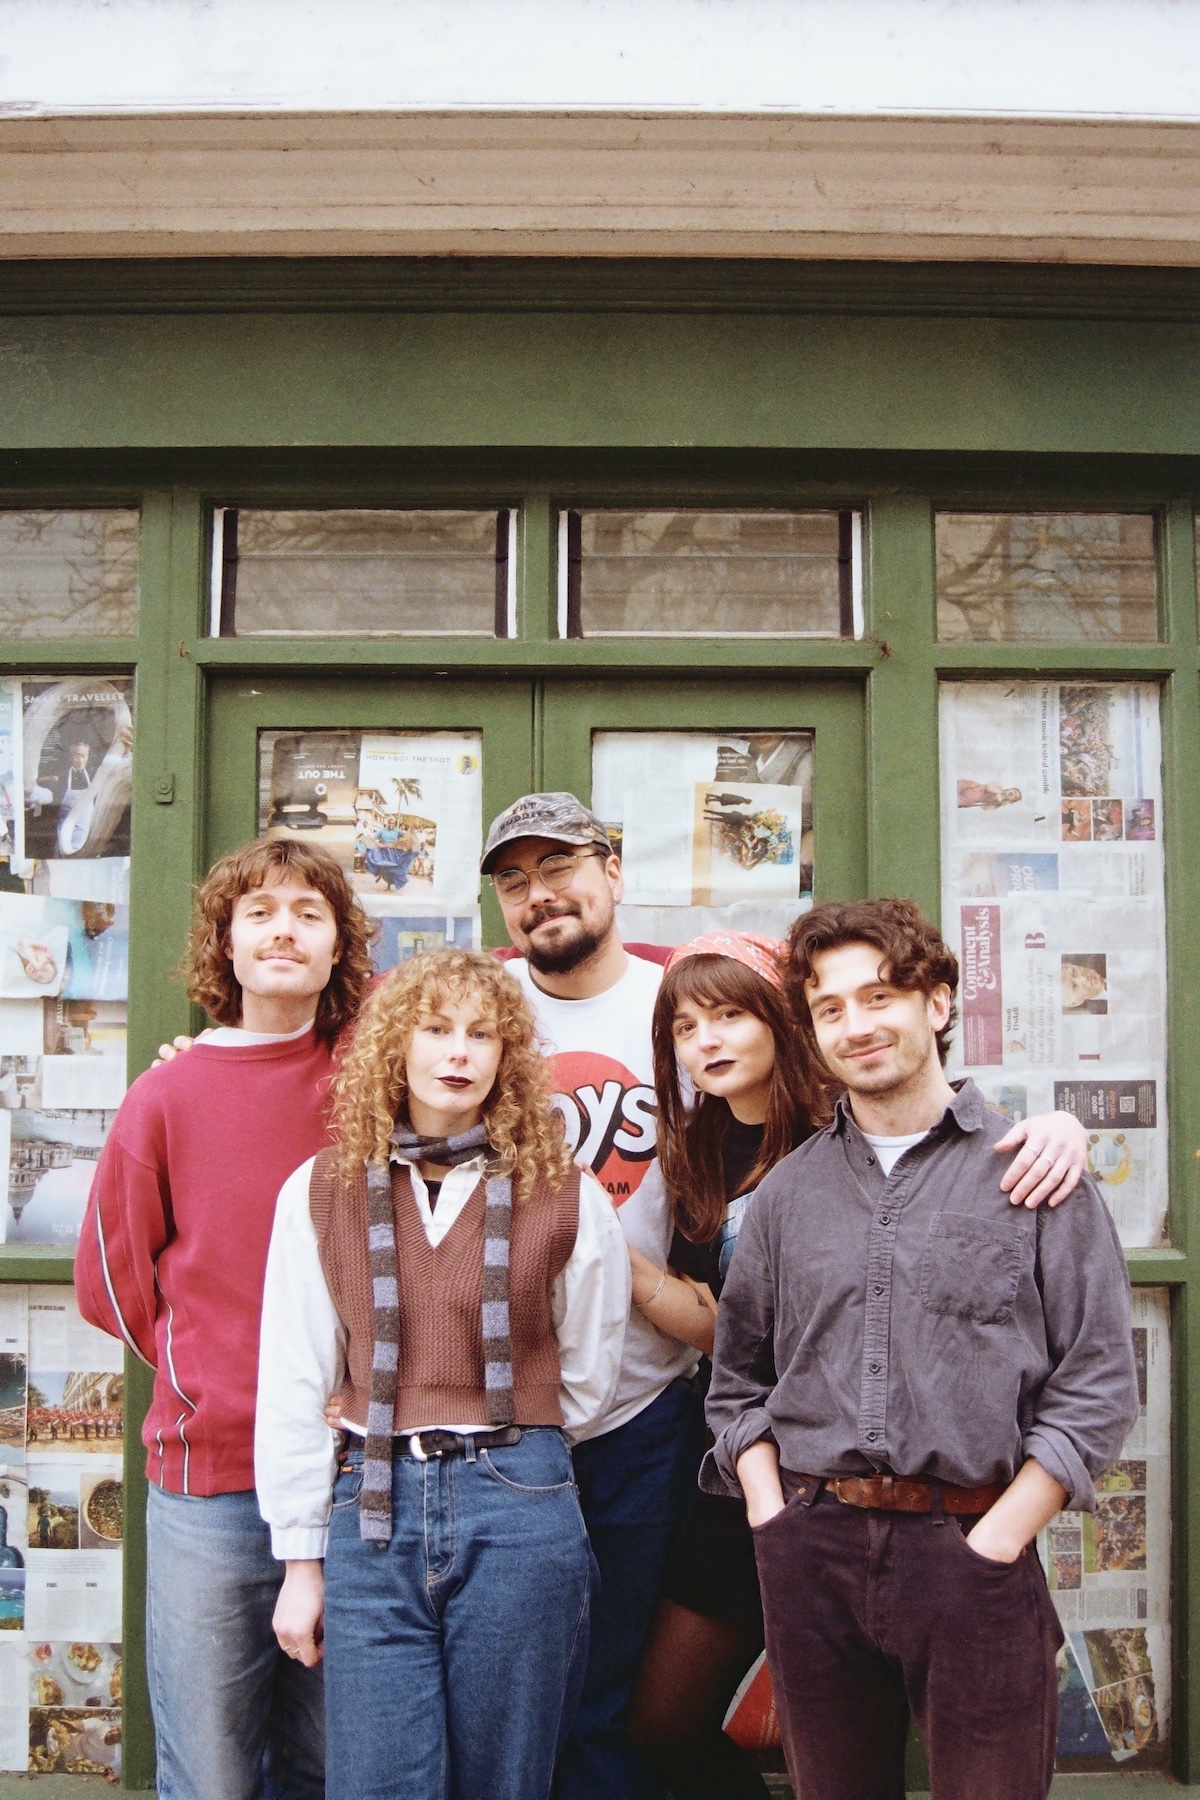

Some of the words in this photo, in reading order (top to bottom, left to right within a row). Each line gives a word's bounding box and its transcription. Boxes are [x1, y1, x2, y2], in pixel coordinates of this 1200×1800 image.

[67, 692, 125, 702] TRAVELLER
[430, 756, 450, 764] SHOT
[298, 770, 321, 779] OUT
[322, 770, 346, 779] THE
[511, 802, 537, 815] FAT
[1024, 932, 1046, 950] B
[963, 926, 978, 1001] Comment
[606, 1181, 630, 1195] AM
